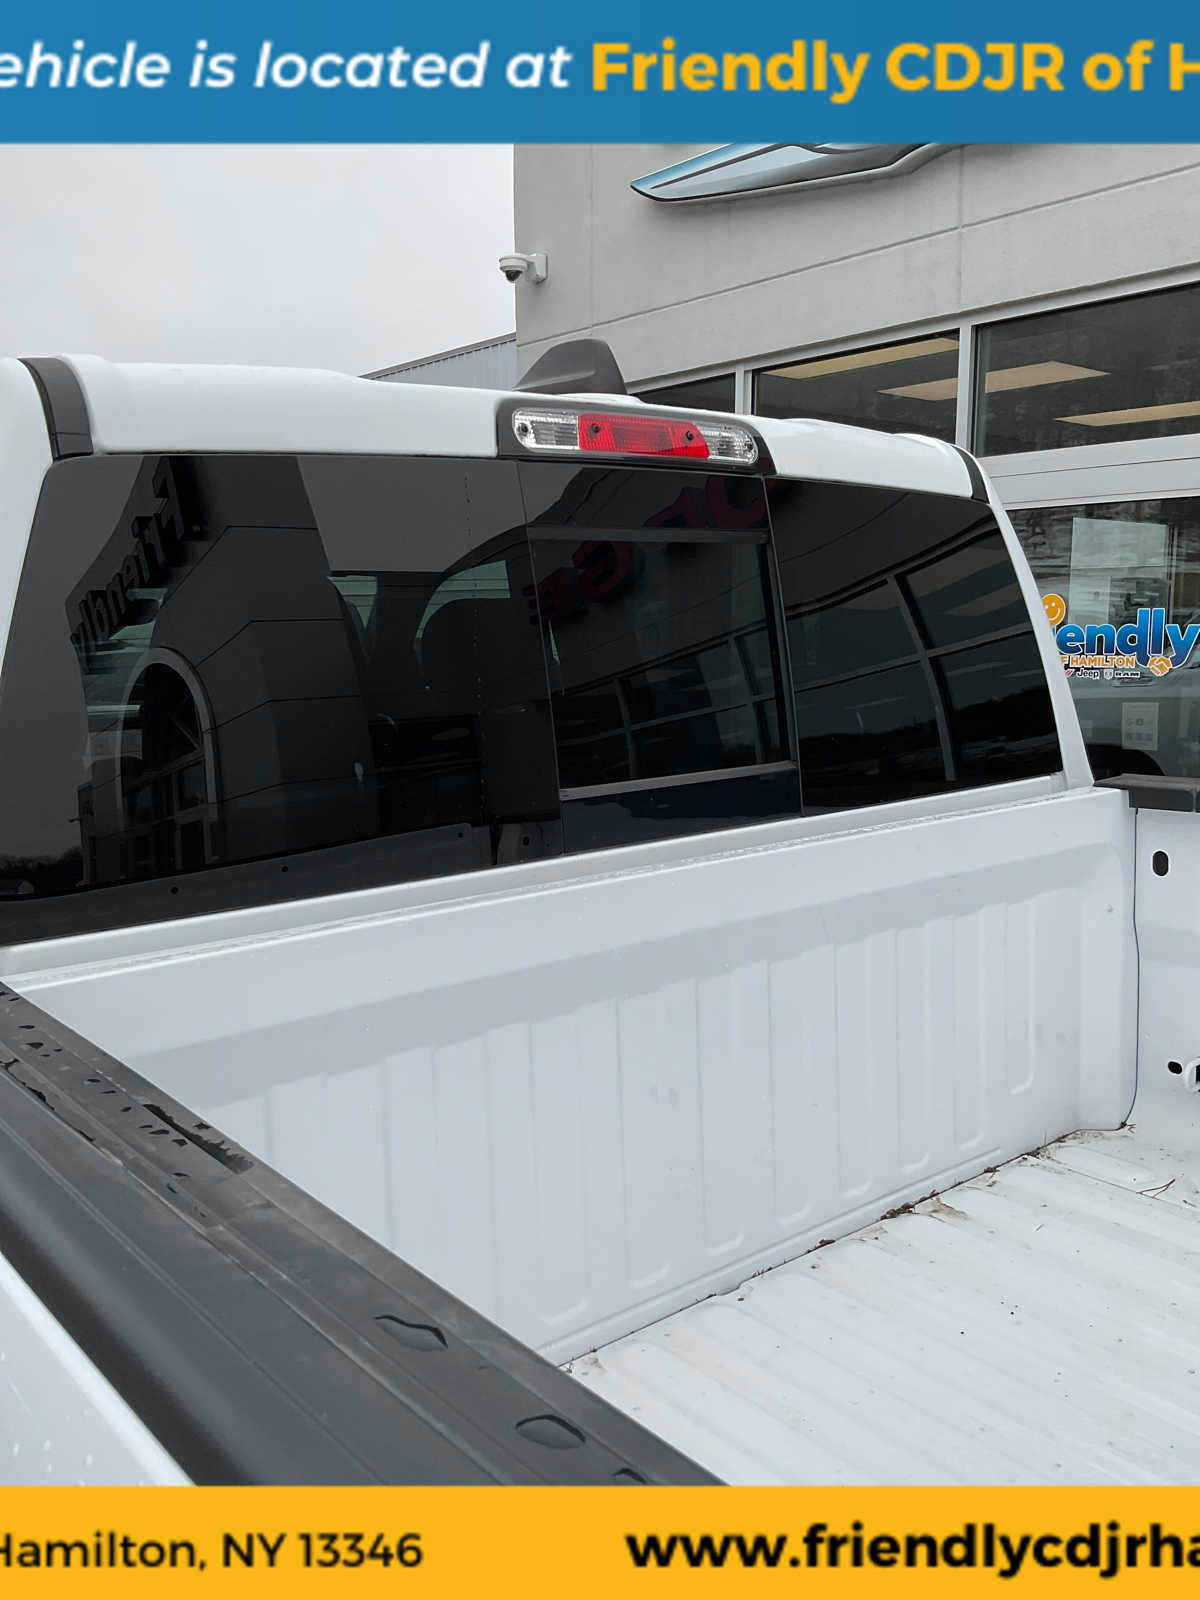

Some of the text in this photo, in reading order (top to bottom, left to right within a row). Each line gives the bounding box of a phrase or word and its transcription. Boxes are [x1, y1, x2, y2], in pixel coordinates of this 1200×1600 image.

[1051, 606, 1200, 669] endly
[1070, 655, 1136, 668] HAMILTON
[1076, 668, 1100, 680] Jeep
